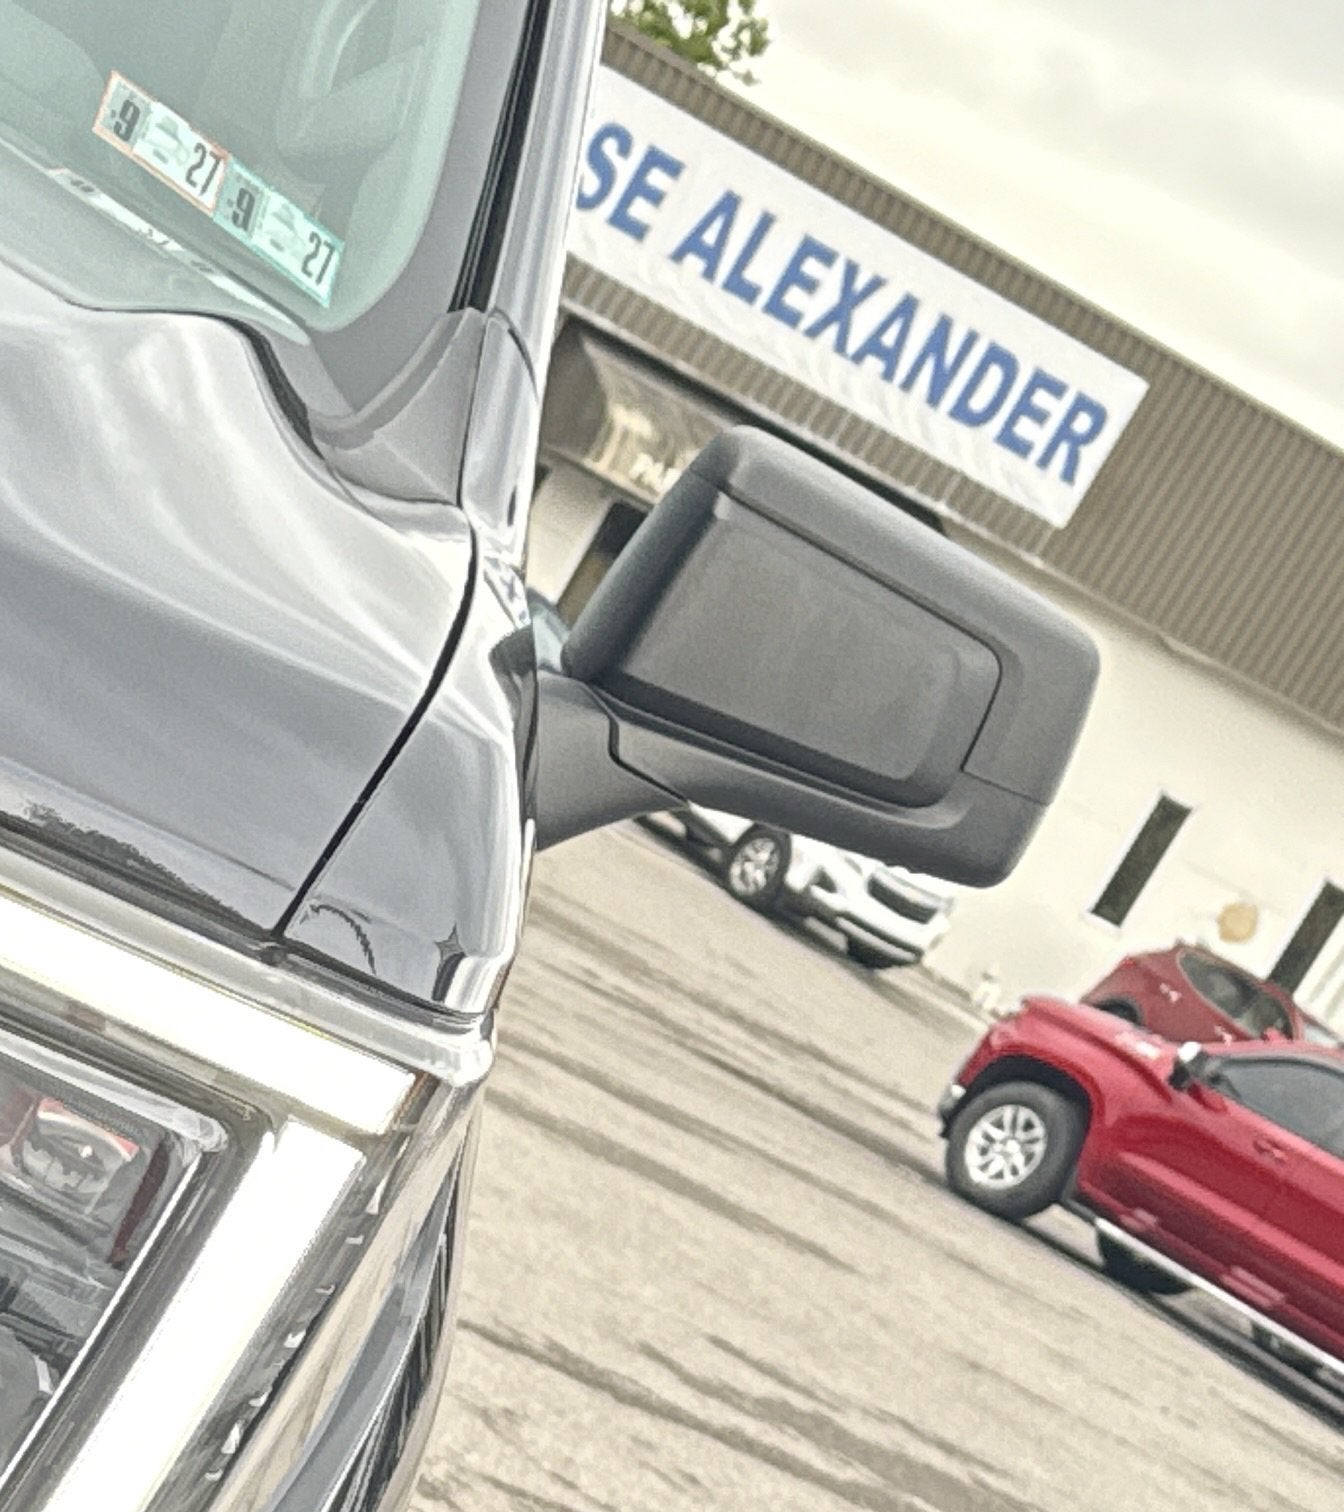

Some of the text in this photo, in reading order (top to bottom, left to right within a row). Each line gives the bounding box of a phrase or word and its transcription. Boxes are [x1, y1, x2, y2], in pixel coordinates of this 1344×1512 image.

[113, 99, 223, 195] 9 27
[231, 187, 336, 285] 9 27
[576, 121, 1108, 485] SE ALEXANDER
